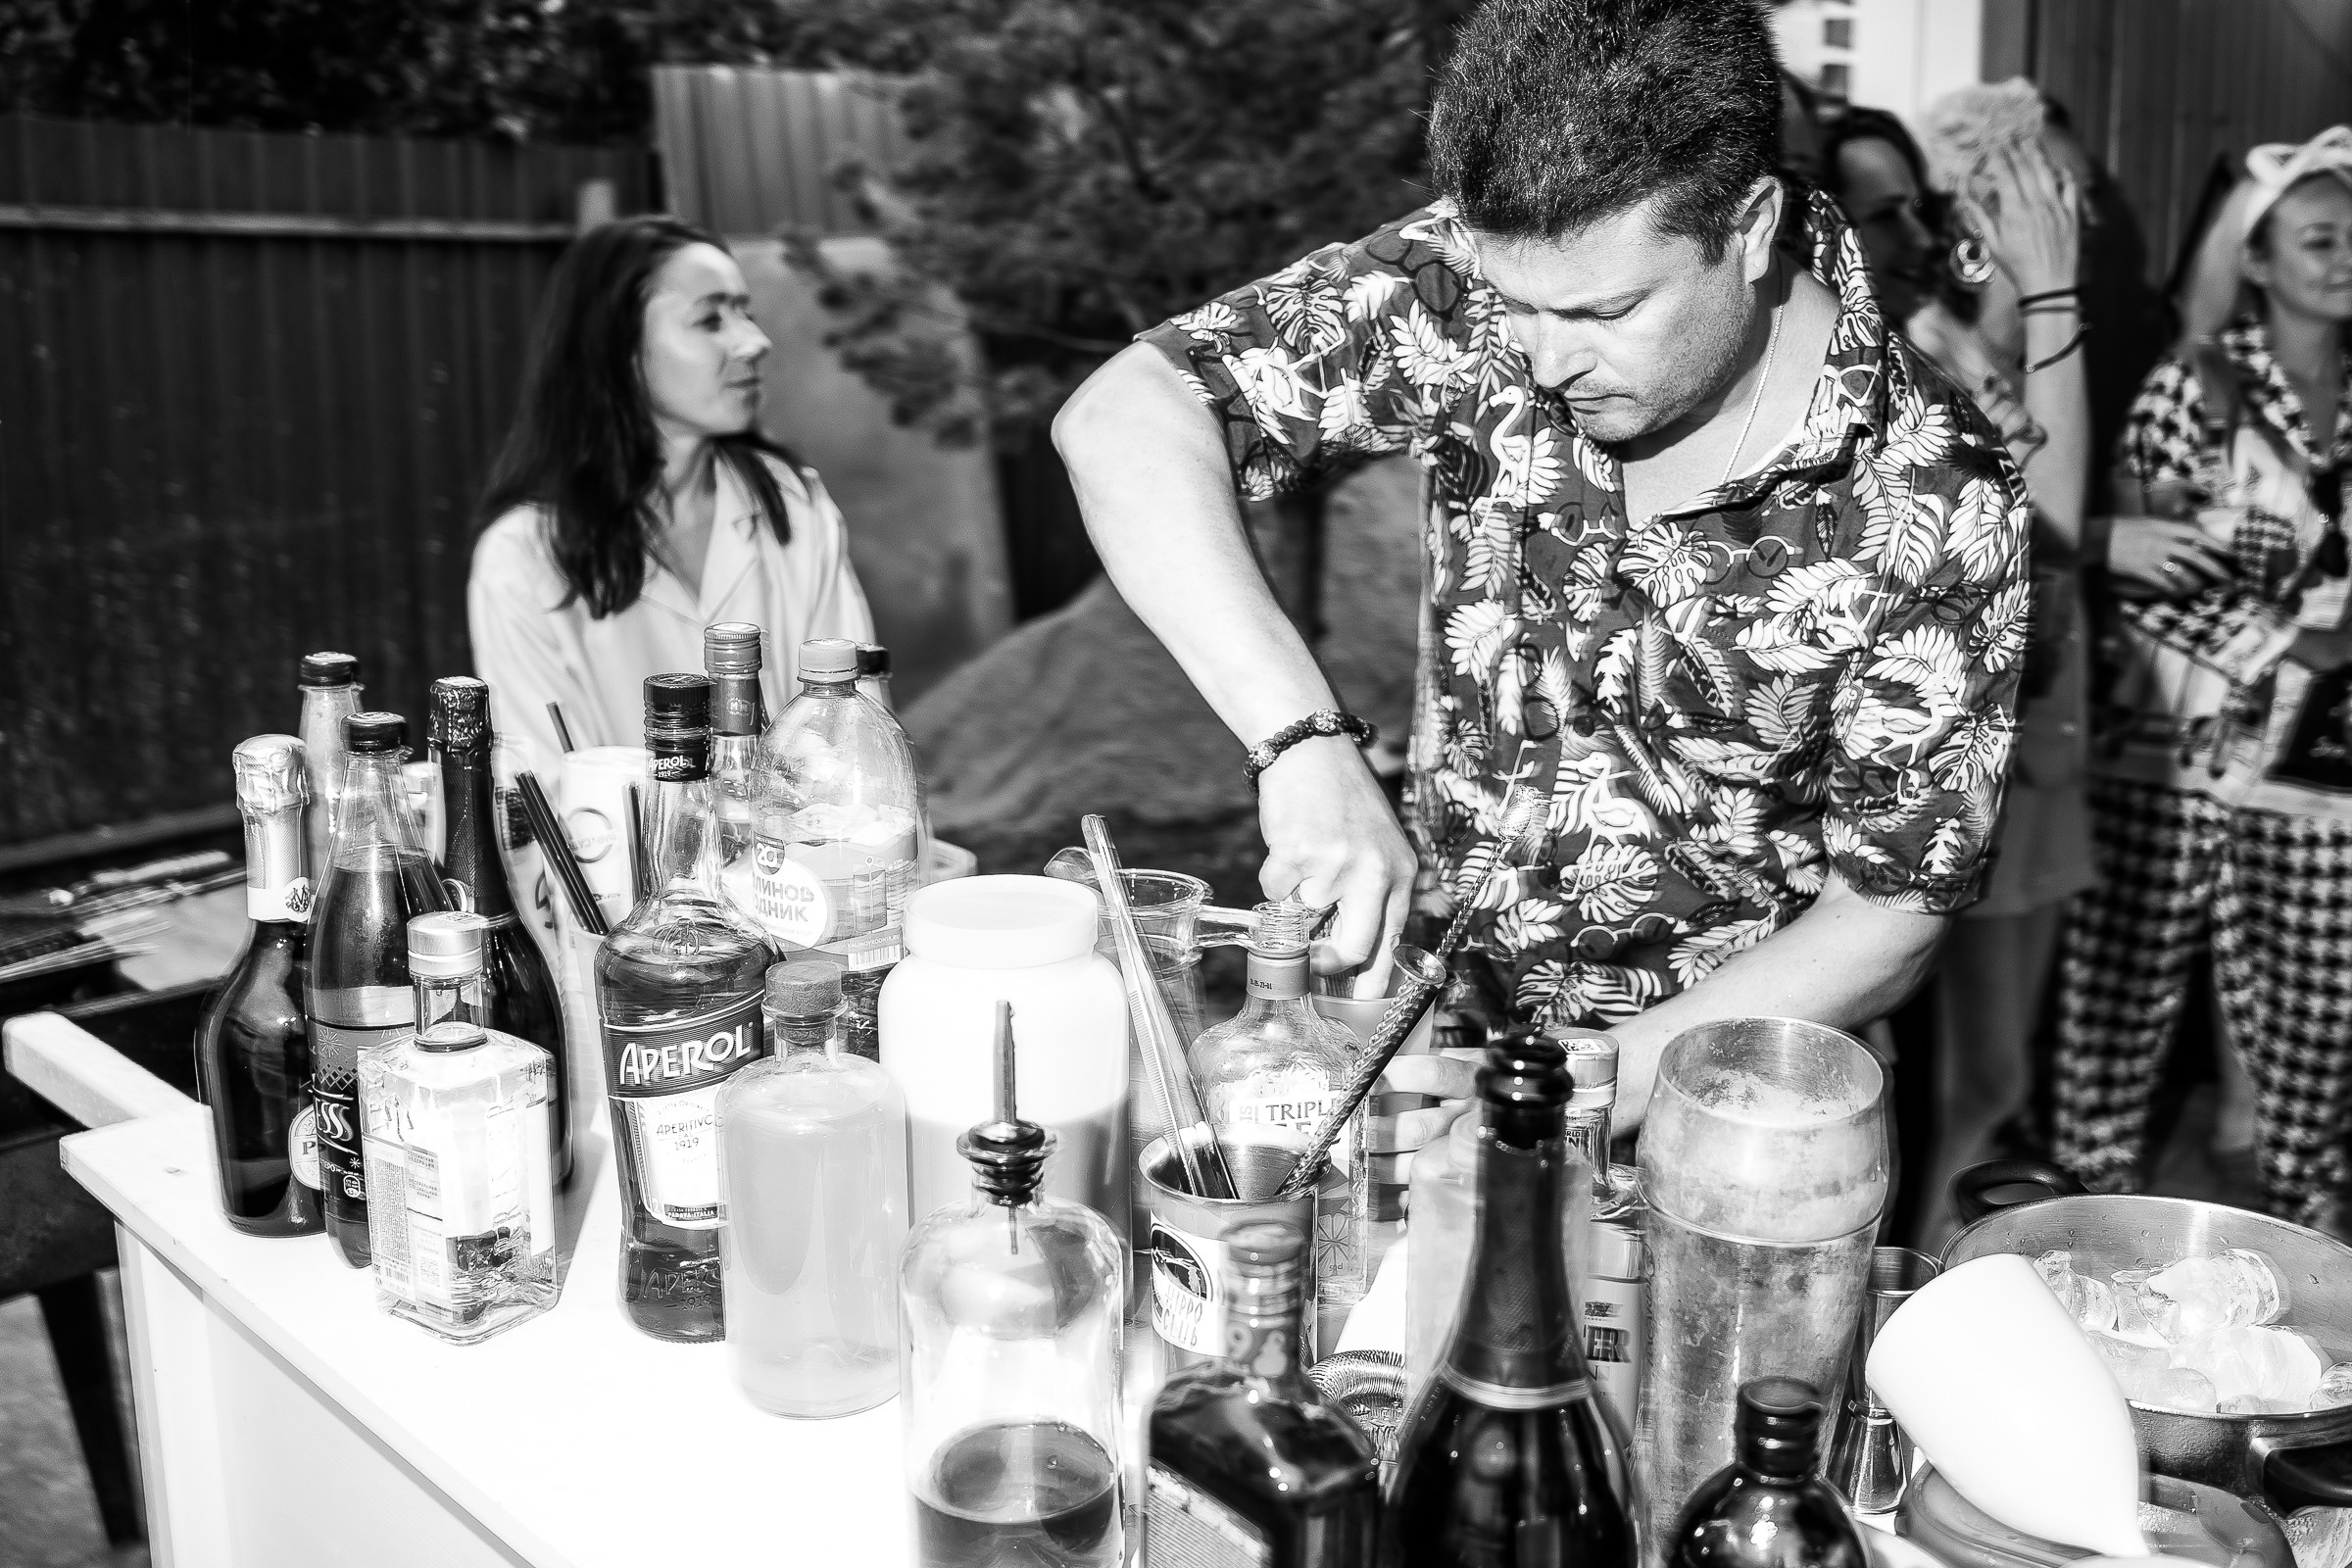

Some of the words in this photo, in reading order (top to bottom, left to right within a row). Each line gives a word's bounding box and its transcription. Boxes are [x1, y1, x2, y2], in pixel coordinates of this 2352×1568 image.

[649, 756, 687, 772] APEROL
[754, 875, 815, 903] ЛИНОВ
[619, 1024, 751, 1085] APEROL
[673, 1137, 700, 1152] 1919
[1565, 1130, 1581, 1139] RLD
[1164, 1284, 1202, 1325] HIPPO
